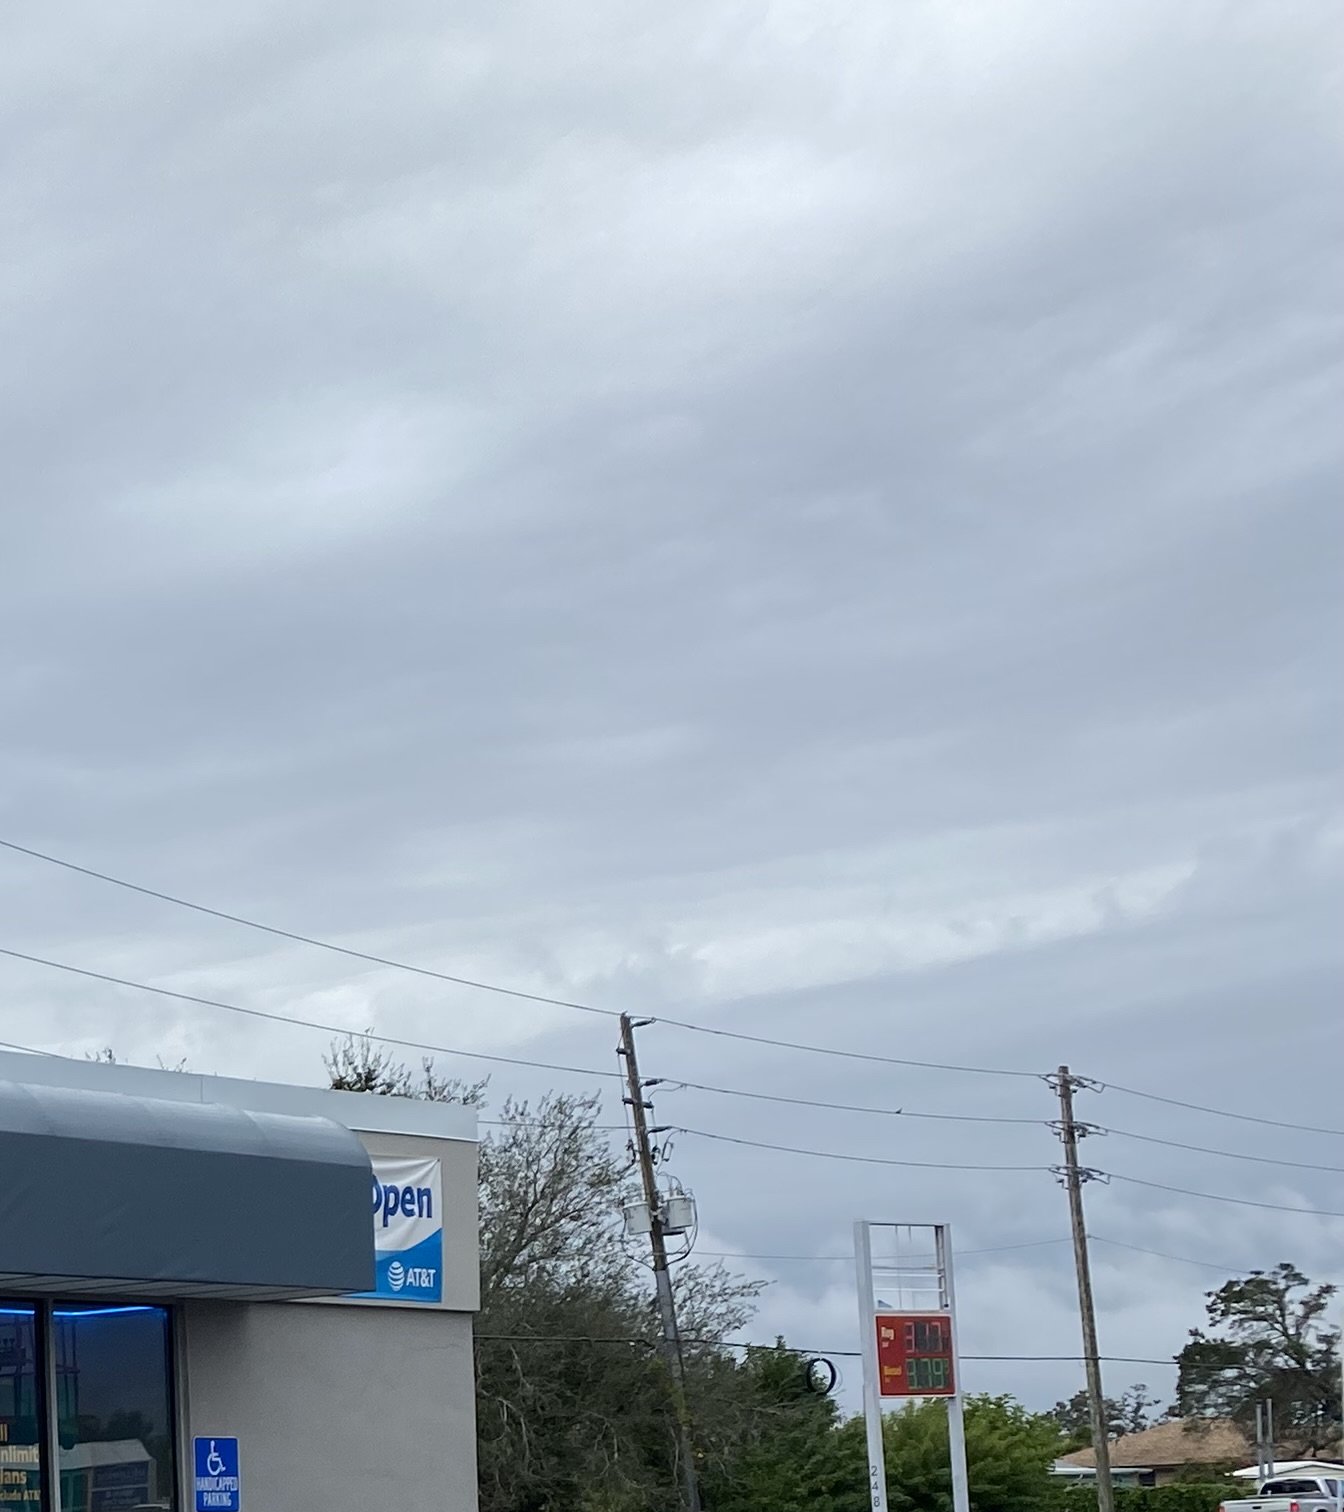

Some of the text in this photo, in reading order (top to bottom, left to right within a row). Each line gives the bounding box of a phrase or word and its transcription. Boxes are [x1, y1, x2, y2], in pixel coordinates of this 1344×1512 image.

[405, 1268, 437, 1288] AT&T
[195, 1477, 238, 1491] HANDICAPPED
[203, 1492, 232, 1506] PARKING
